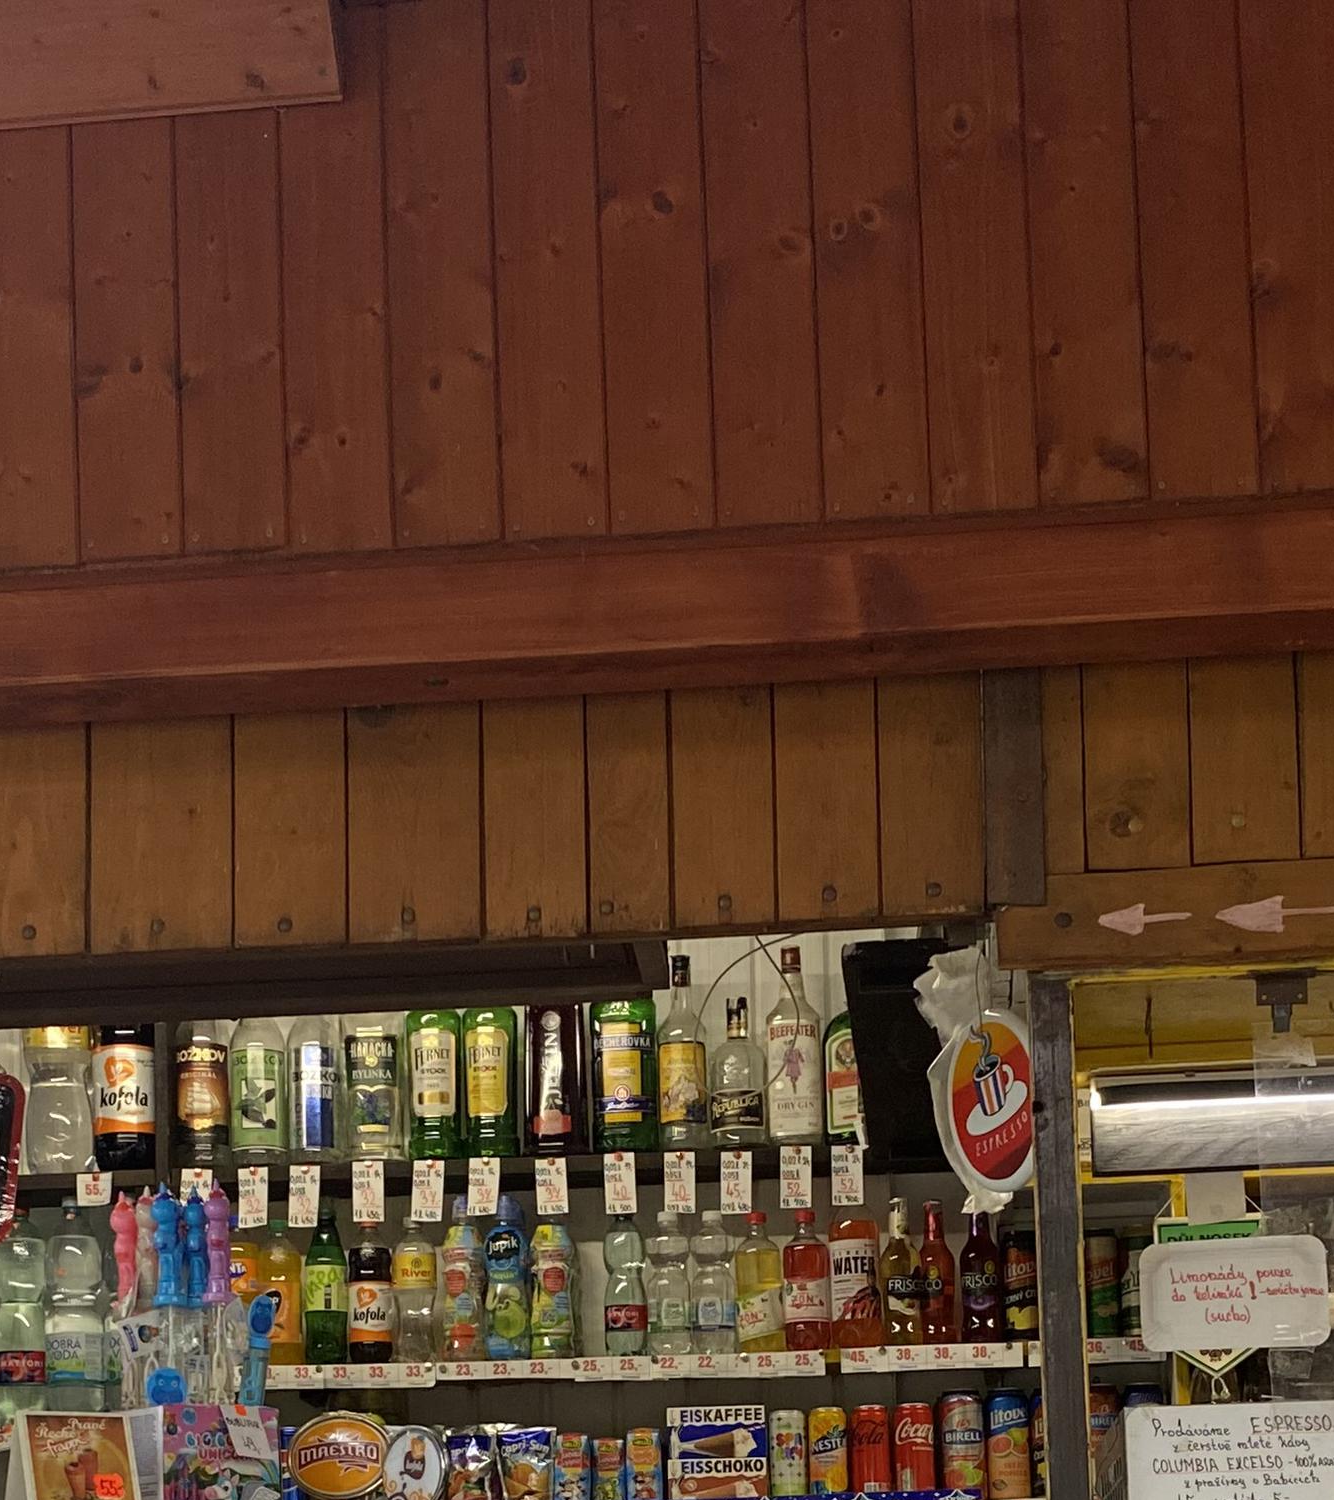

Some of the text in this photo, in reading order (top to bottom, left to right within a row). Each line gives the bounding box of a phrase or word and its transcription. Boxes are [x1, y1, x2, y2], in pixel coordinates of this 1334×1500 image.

[769, 1023, 817, 1041] BEEFEATER
[352, 1069, 393, 1080] BYLINKA
[99, 1083, 149, 1113] kofola
[975, 1110, 1028, 1158] ESPRESSO
[401, 1267, 432, 1279] River
[833, 1256, 876, 1276] WATER
[353, 1308, 387, 1326] kofola
[679, 1407, 764, 1423] EISKAFFEE
[1250, 1415, 1333, 1434] ESPRESSO
[944, 1430, 982, 1444] BIRELL
[299, 1444, 379, 1465] MAESTRO
[680, 1458, 765, 1474] EISSCHOKO
[1152, 1455, 1284, 1475] COLUMBIA EXCELSO
